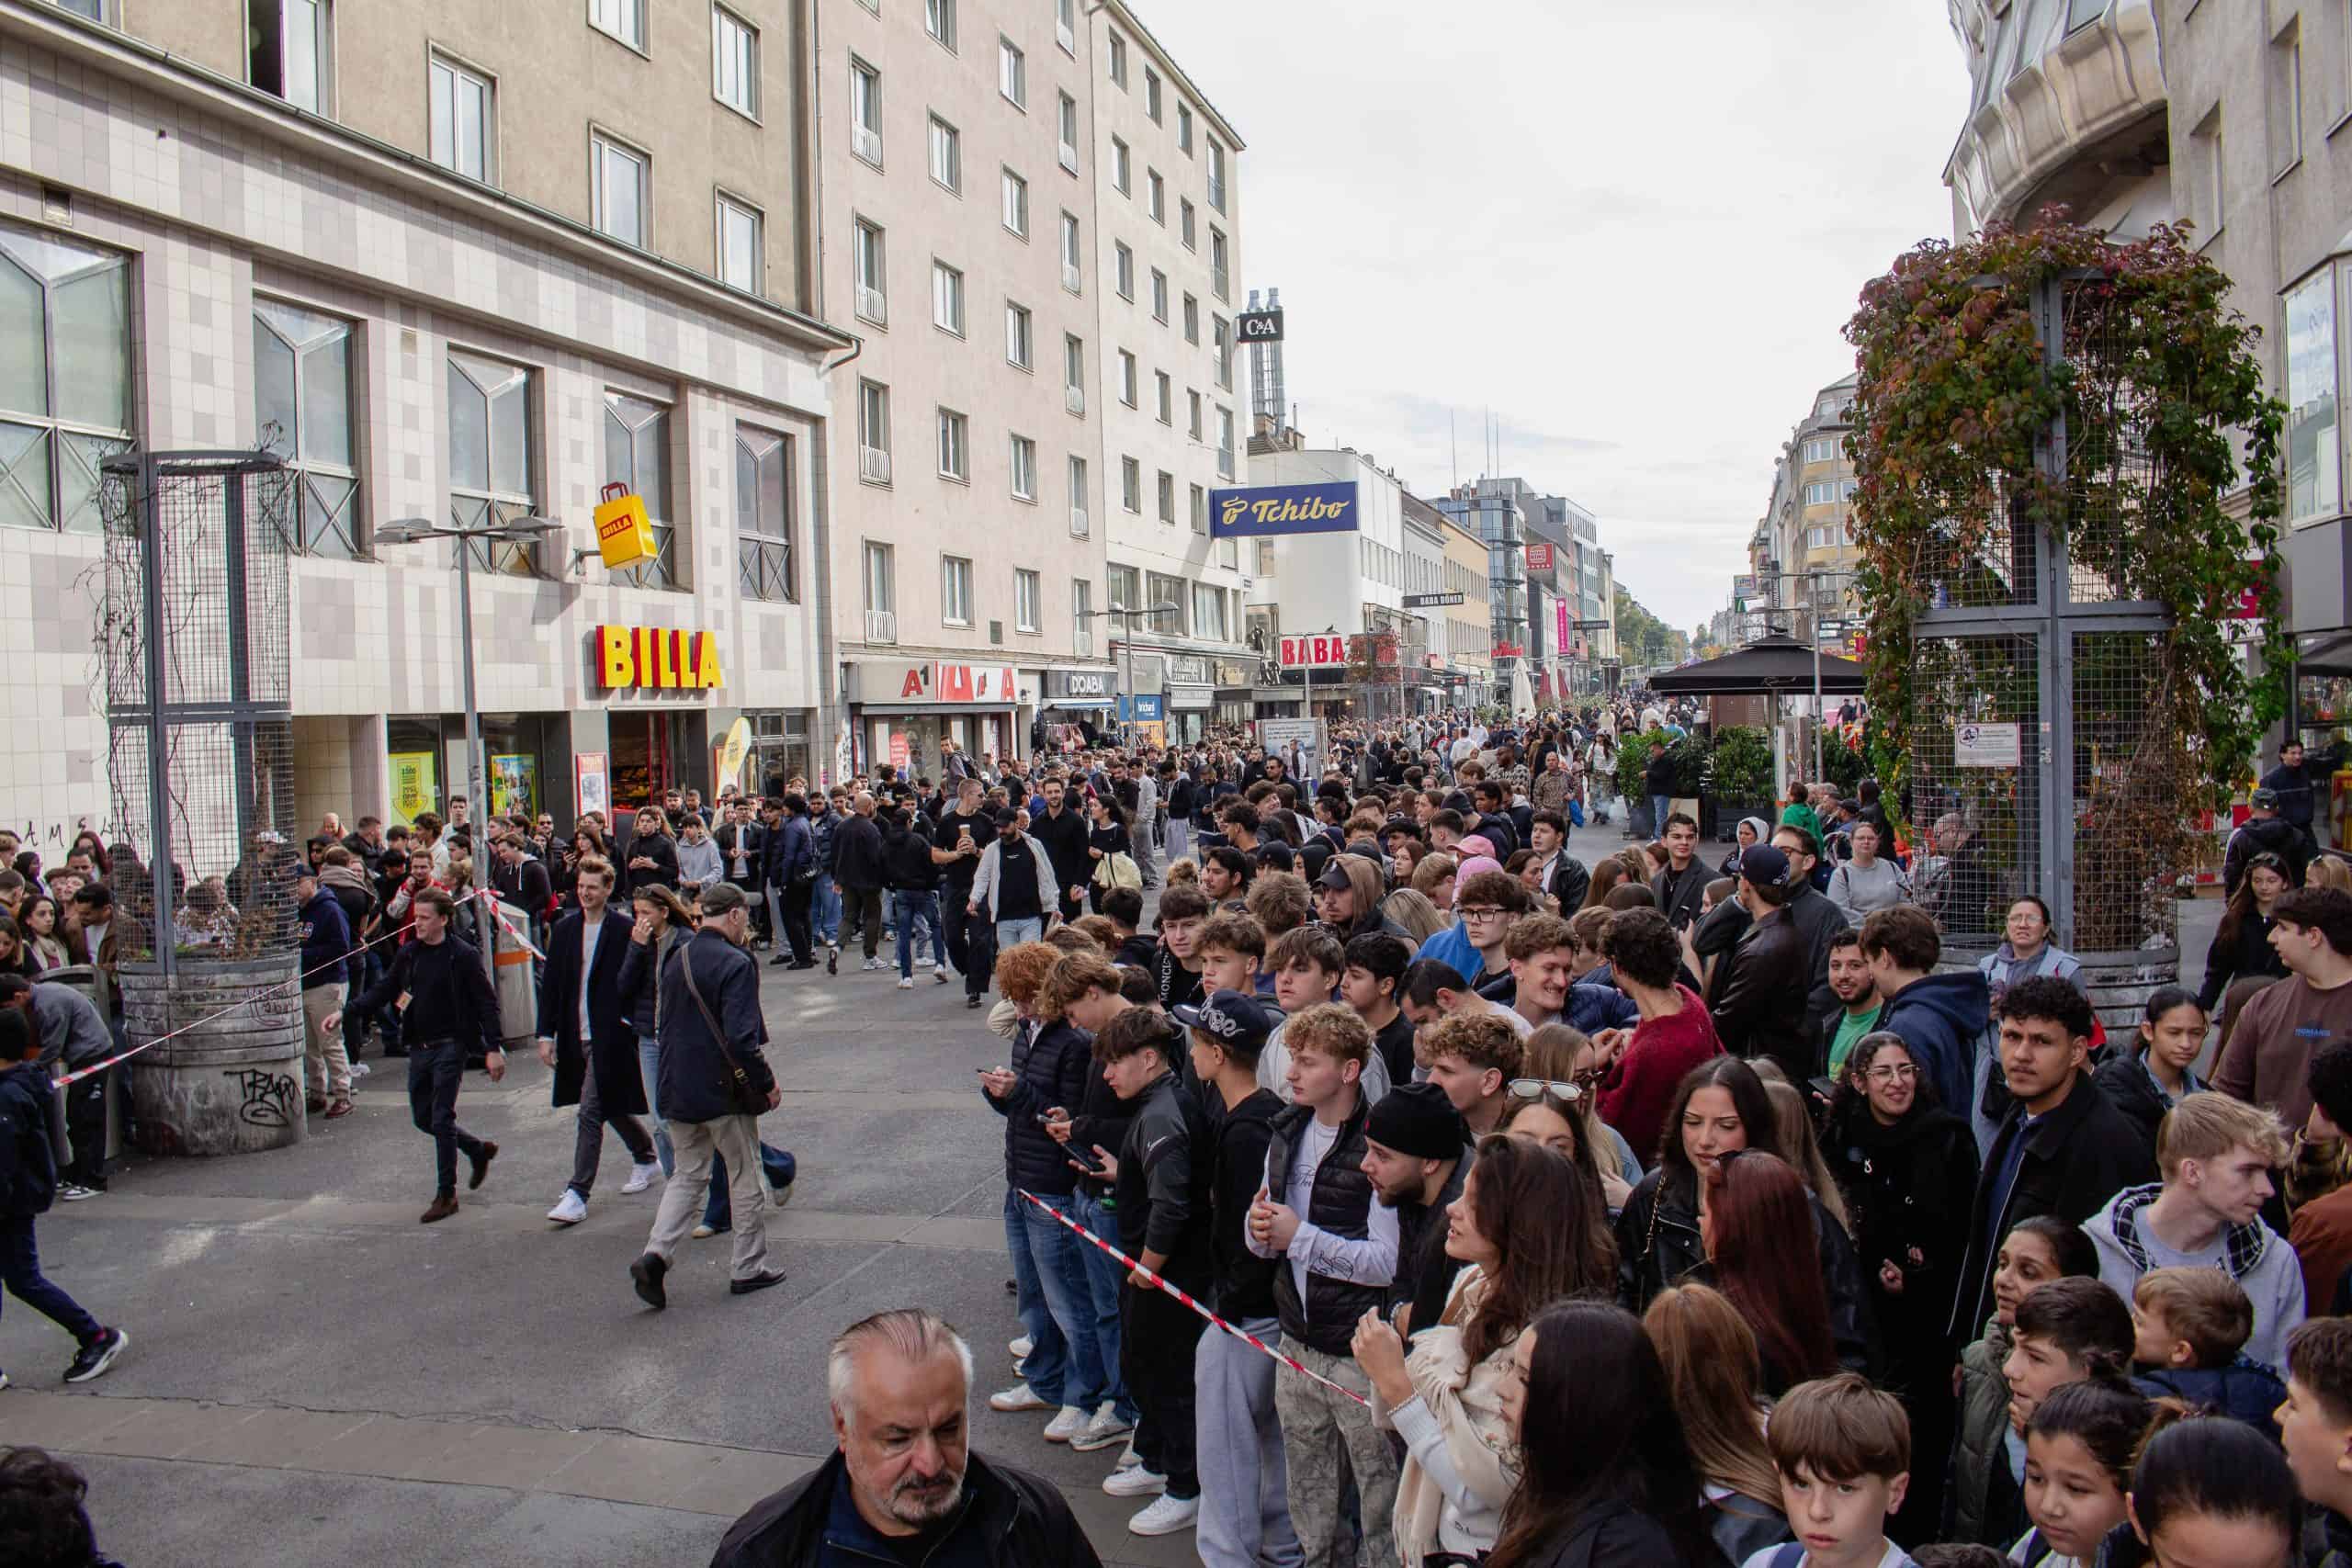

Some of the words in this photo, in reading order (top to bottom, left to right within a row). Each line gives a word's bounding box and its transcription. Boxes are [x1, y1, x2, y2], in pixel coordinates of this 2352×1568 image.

[1246, 317, 1278, 335] C&A
[1250, 496, 1351, 524] Tchibo
[602, 516, 631, 537] BILLA
[595, 625, 723, 688] BILLA
[1281, 637, 1345, 665] BABA
[901, 665, 930, 698] A1
[1071, 675, 1104, 694] DOABA
